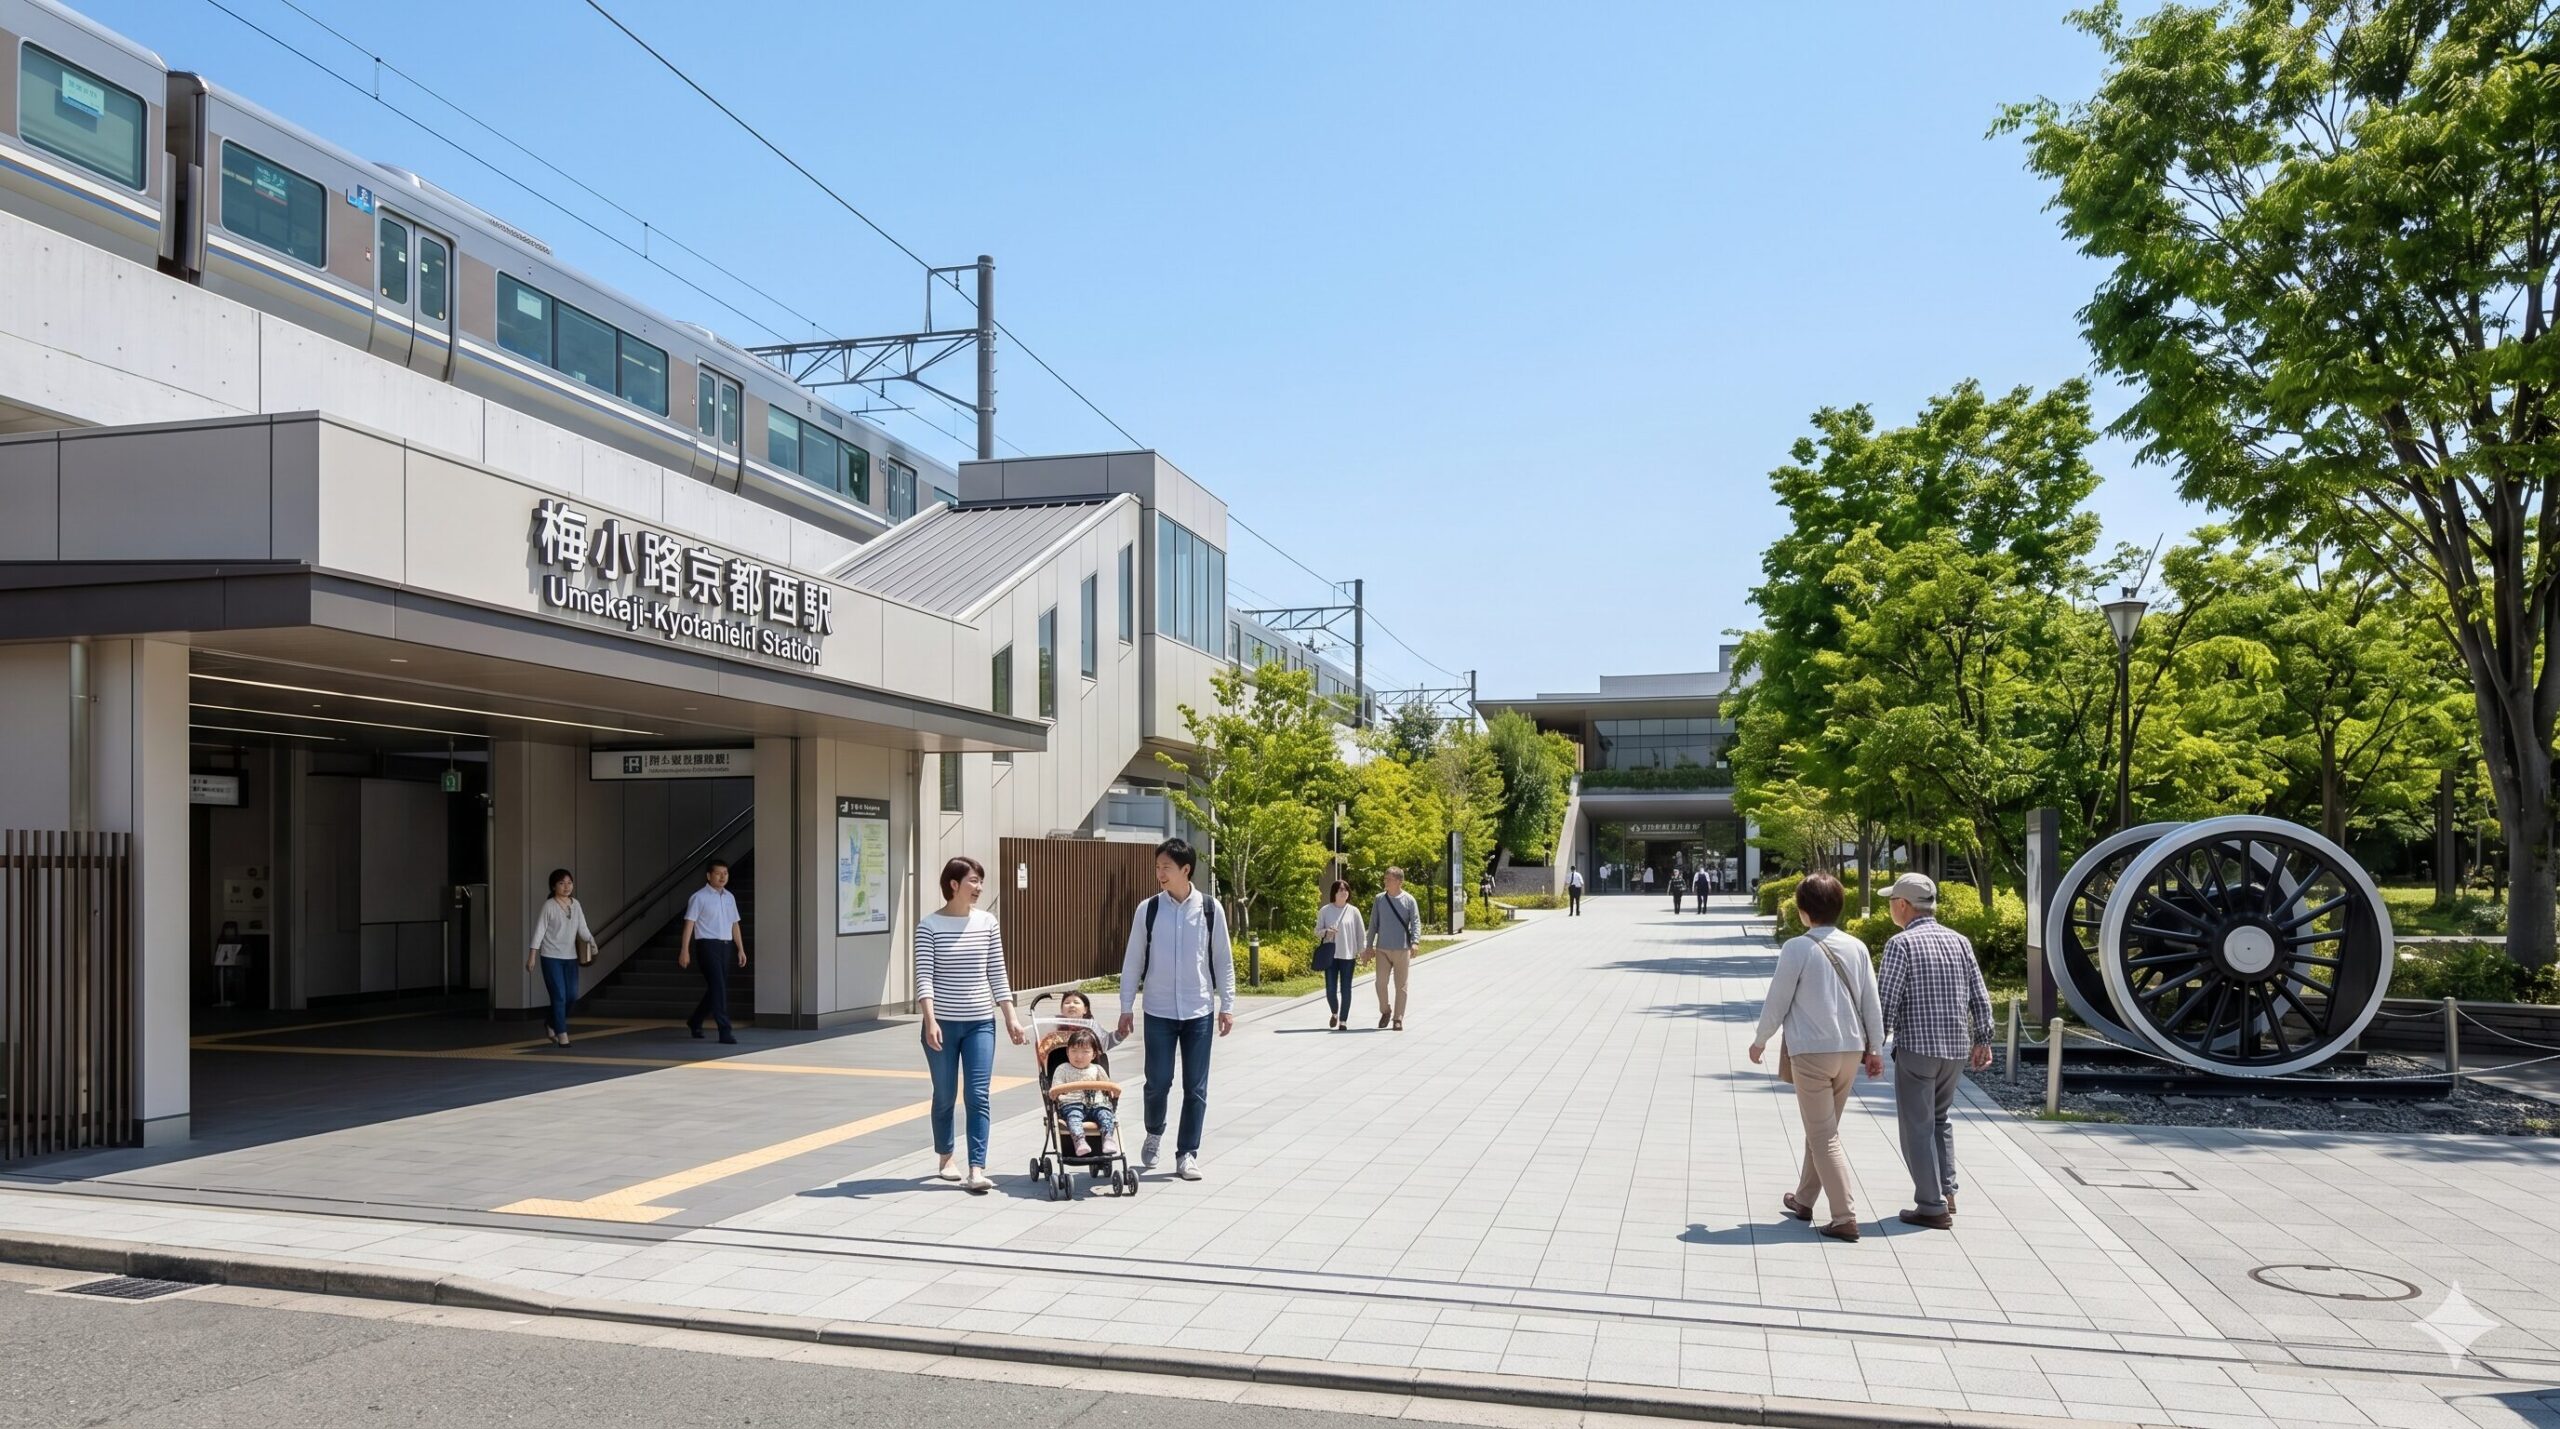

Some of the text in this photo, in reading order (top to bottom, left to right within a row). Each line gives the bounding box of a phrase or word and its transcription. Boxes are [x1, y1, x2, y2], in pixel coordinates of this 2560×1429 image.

[536, 499, 833, 635] 梅小路京都西駅
[761, 629, 822, 666] Station
